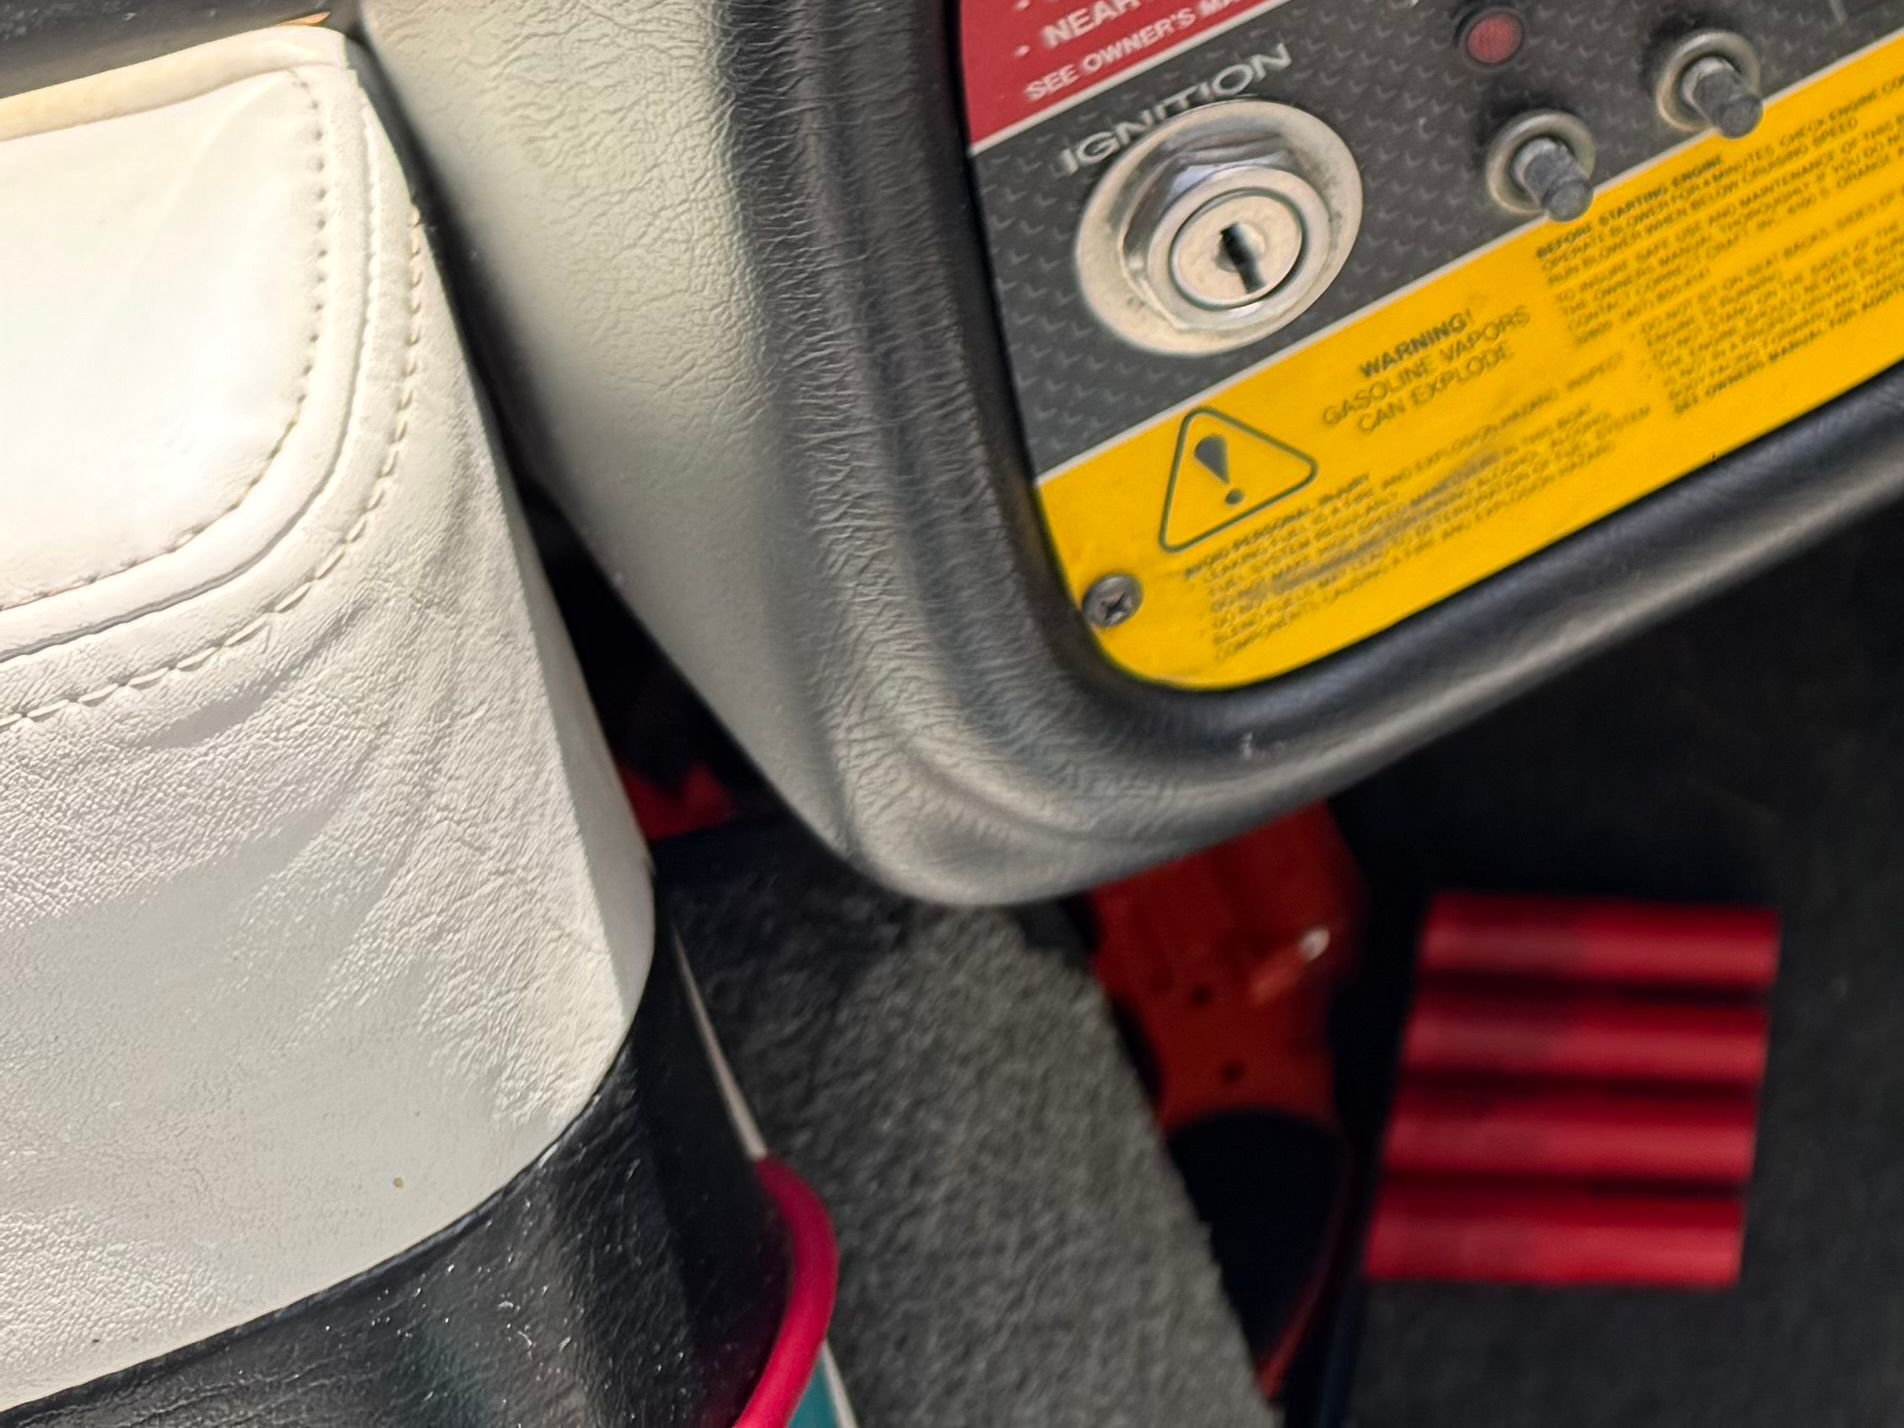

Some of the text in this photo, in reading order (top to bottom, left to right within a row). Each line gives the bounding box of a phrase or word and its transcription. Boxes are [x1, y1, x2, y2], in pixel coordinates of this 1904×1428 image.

[1023, 63, 1080, 101] SEE
[1079, 6, 1197, 74] OWNER'S
[1061, 41, 1295, 175] IGNITION
[1359, 308, 1474, 378] WARNING!
[1358, 398, 1406, 434] CAN
